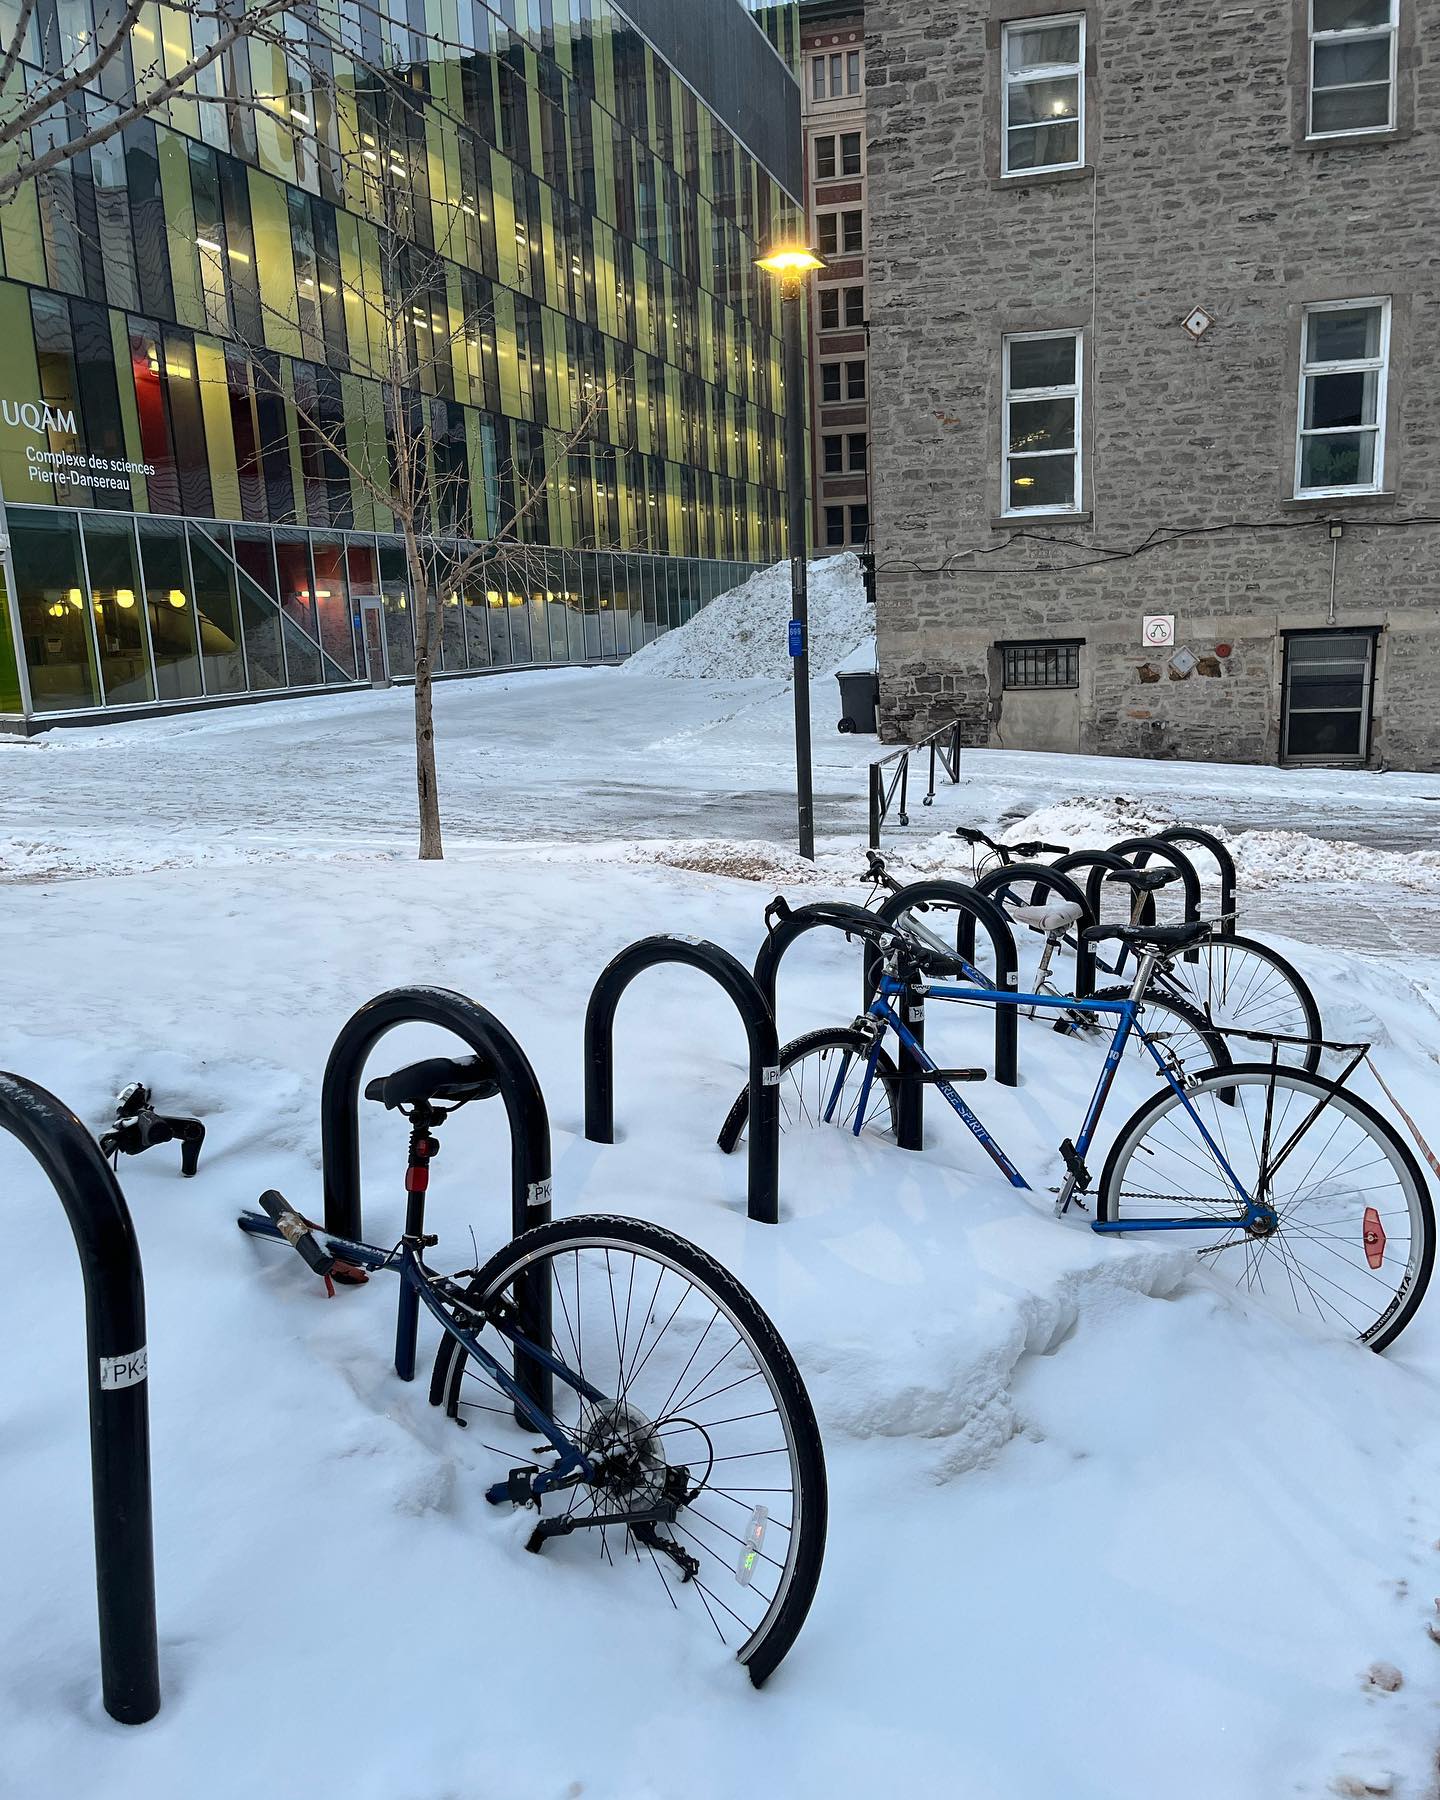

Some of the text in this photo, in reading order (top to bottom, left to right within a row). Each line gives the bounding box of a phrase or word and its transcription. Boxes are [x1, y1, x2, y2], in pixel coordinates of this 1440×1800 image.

[1, 400, 77, 434] UQÀM
[26, 446, 155, 475] Complexe des sciences
[28, 466, 130, 490] Pierre-Dansereau
[957, 1106, 989, 1139] SPIRIT
